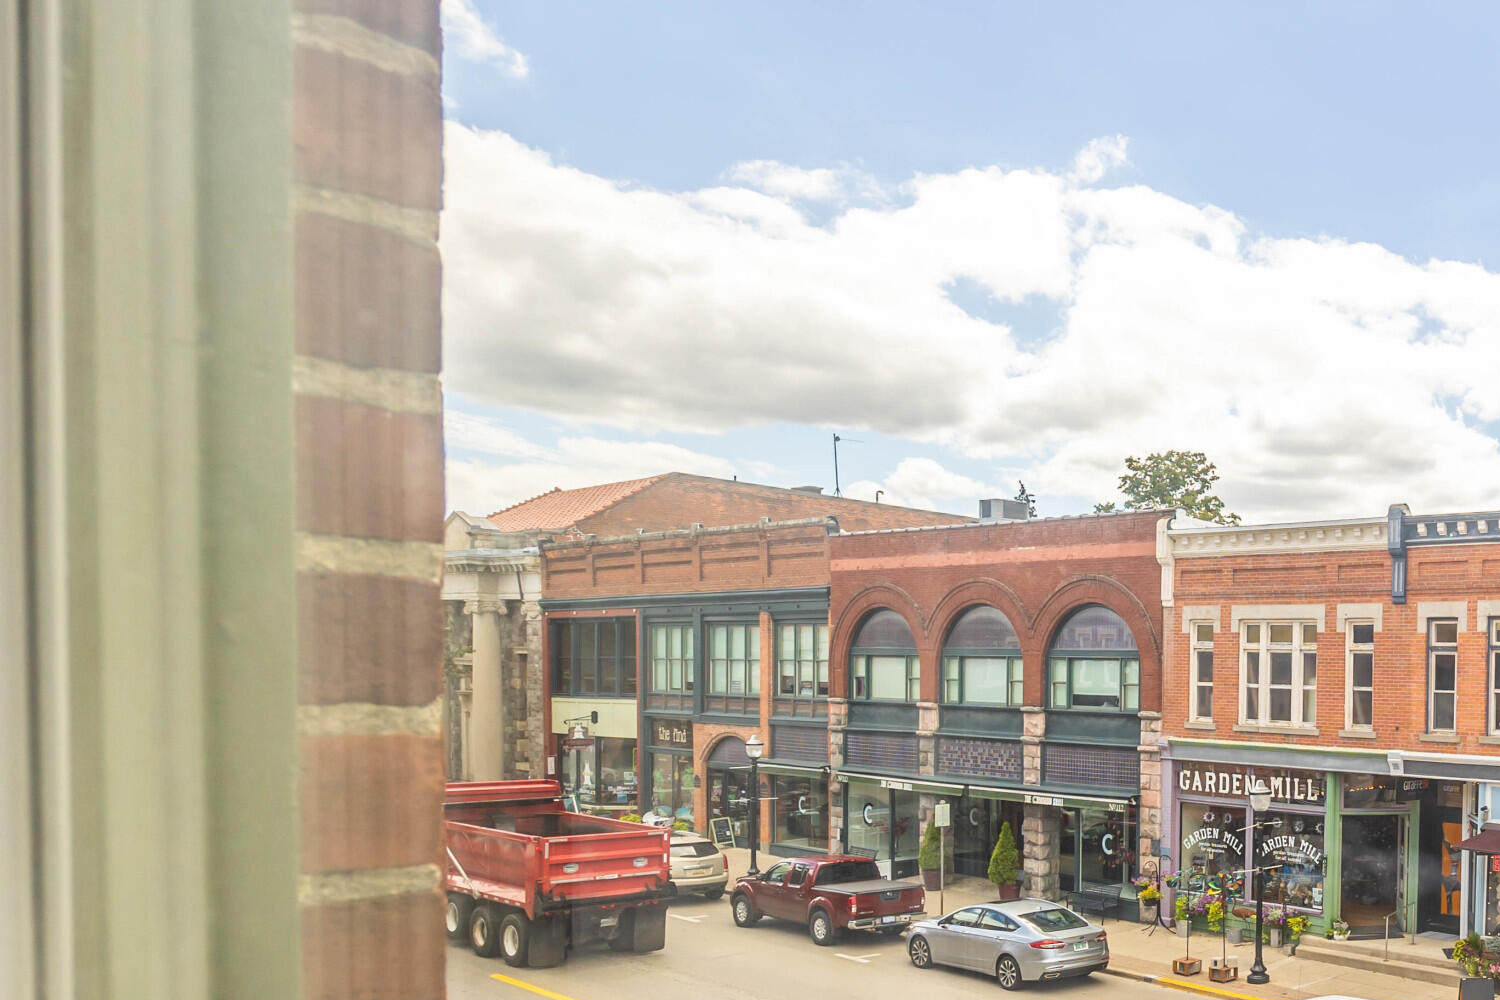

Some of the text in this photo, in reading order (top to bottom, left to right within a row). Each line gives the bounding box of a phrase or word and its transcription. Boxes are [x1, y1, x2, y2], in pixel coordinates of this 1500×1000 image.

[1180, 769, 1318, 801] GARDEN MILL
[1101, 833, 1113, 856] C
[1183, 828, 1244, 856] GARDEN MILL
[1300, 840, 1321, 865] MILL
